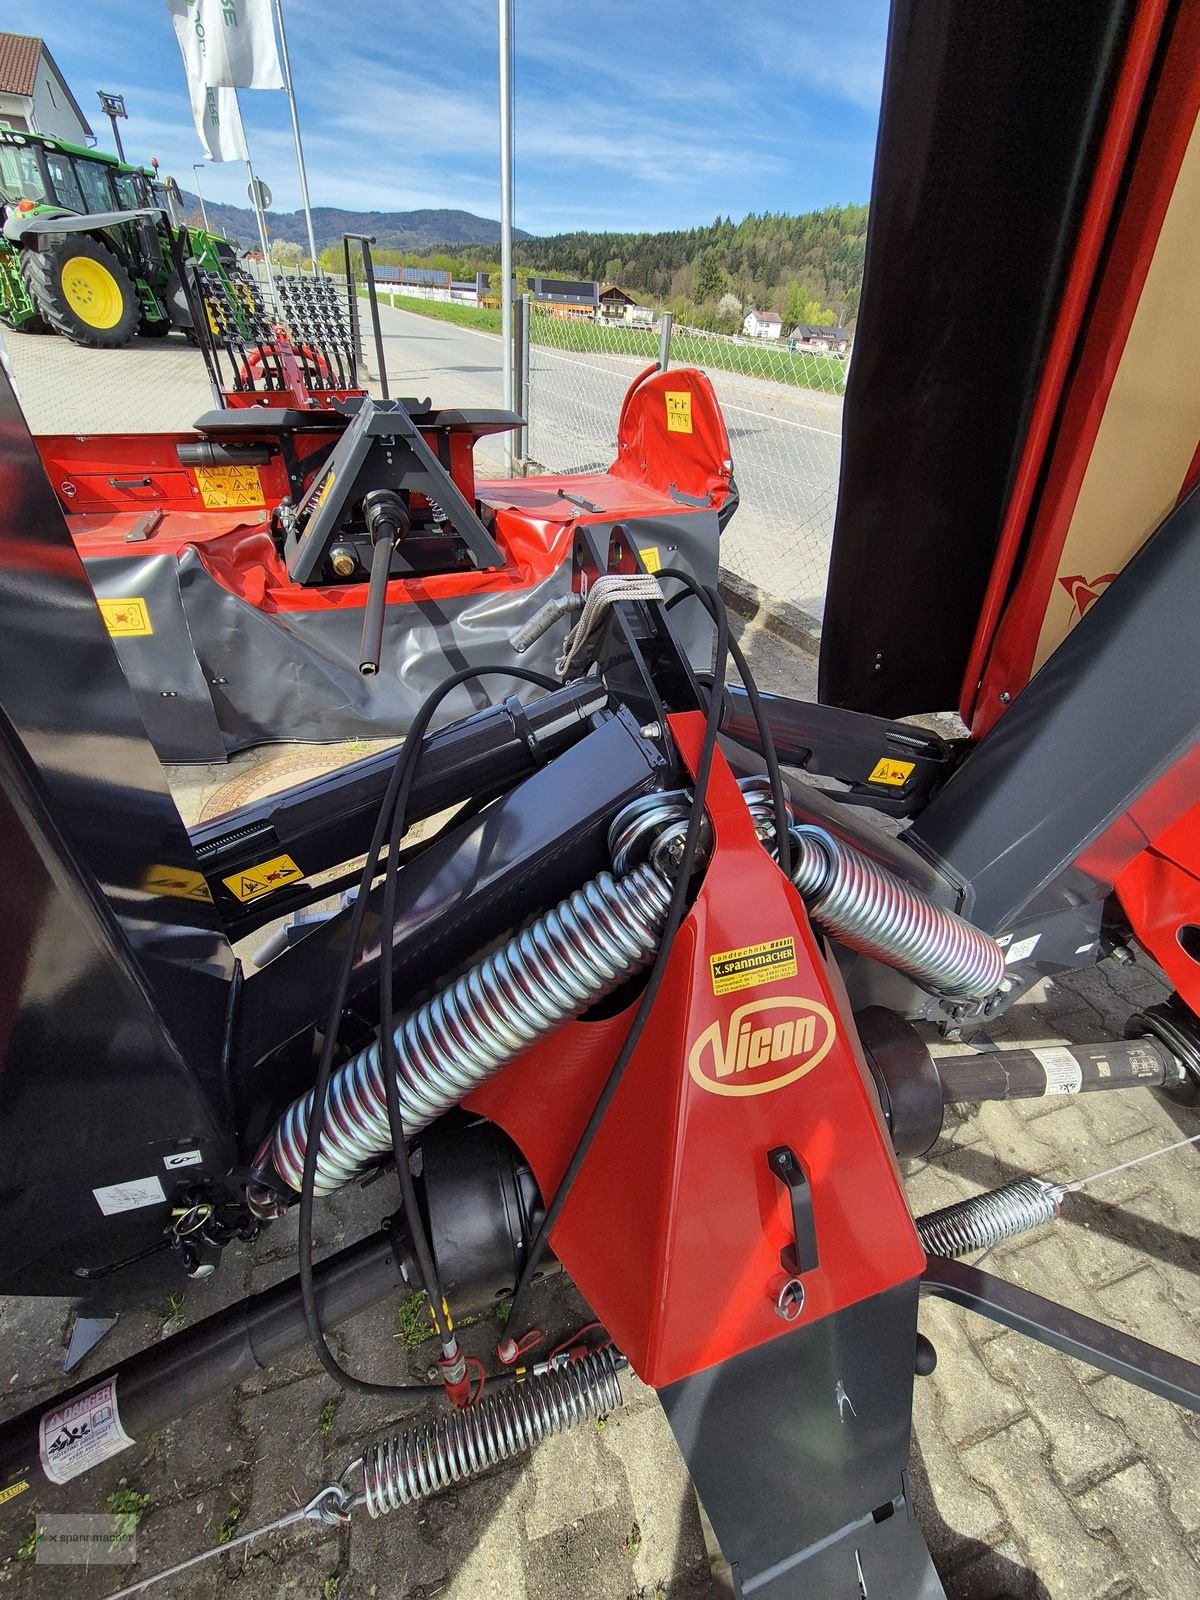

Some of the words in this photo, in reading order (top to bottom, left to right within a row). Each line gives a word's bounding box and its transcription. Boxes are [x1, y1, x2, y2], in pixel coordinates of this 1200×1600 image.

[712, 945, 767, 962] Landtechnik
[712, 1013, 817, 1078] Vicon
[63, 1386, 111, 1420] DANGER
